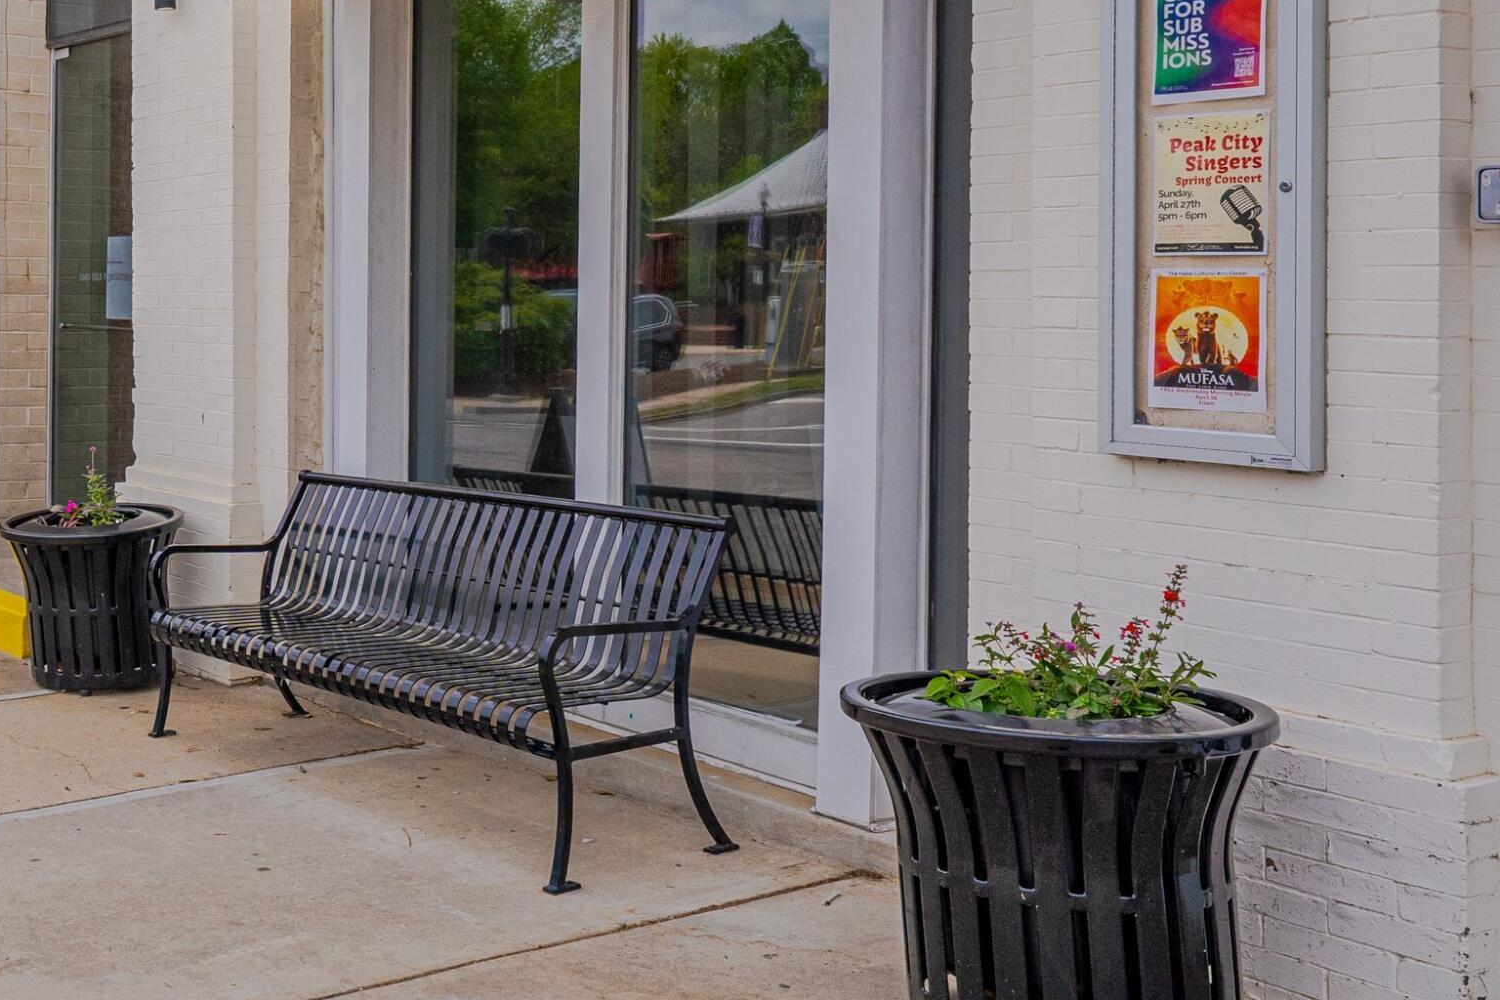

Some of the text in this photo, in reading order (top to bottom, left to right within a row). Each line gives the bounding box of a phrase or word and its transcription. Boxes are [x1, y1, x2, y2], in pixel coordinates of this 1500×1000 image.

[1164, 0, 1205, 19] FOR
[1164, 17, 1203, 35] SUB
[1164, 32, 1210, 52] MISS
[1163, 49, 1212, 69] IONS
[1169, 133, 1263, 154] Peak City
[1185, 155, 1263, 174] Singers
[1175, 174, 1263, 188] Spring Concert
[1158, 200, 1201, 211] April 27th
[1158, 212, 1178, 222] 5pm
[1185, 210, 1207, 221] 6pm
[1177, 372, 1235, 386] MUFASA
